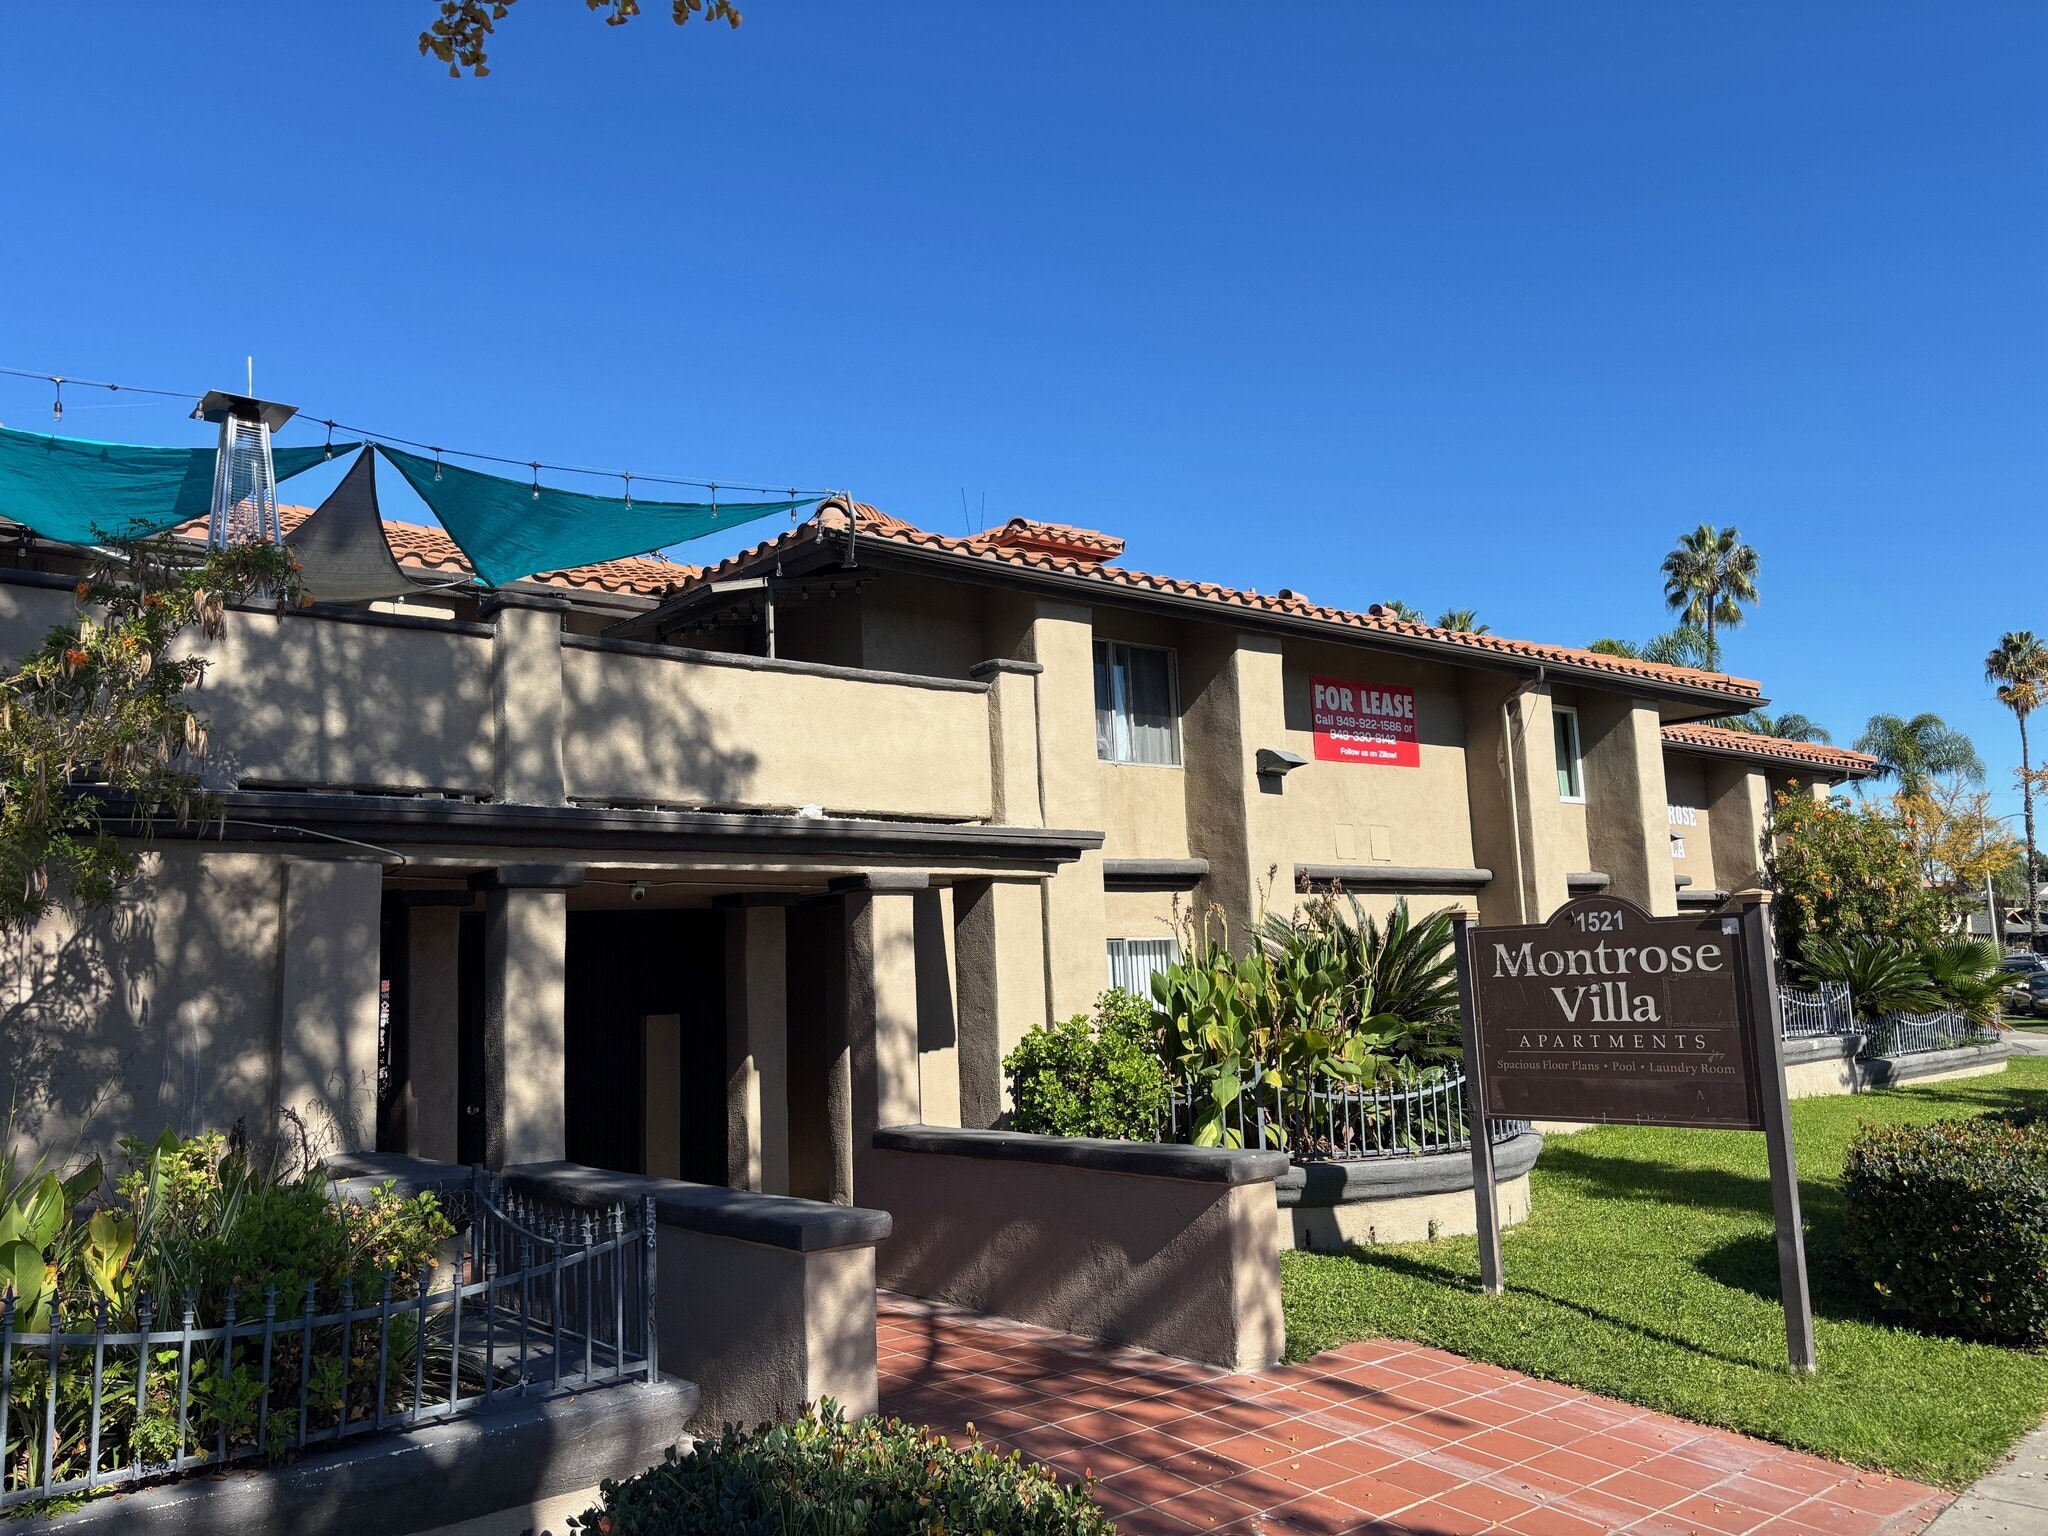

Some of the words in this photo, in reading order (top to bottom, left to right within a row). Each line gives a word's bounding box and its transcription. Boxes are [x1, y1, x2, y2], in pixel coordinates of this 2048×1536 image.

[1315, 684, 1354, 712] FOR
[1361, 690, 1413, 719] LEASE
[1315, 714, 1333, 725] Call
[1336, 716, 1401, 732] 949-922-1586
[1404, 725, 1413, 733] or
[1340, 747, 1359, 756] Follow
[1361, 749, 1369, 757] us
[1378, 750, 1397, 759] Zillow!
[1576, 910, 1624, 932] 1521
[1492, 939, 1724, 978] Montrose
[1550, 981, 1661, 1023] Villa
[1519, 1034, 1706, 1050] APARTMENTS
[1497, 1060, 1540, 1072] Spacious
[1542, 1060, 1569, 1071] Floor
[1571, 1060, 1600, 1071] Plans
[1612, 1061, 1636, 1072] Pool
[1649, 1062, 1698, 1076] Laundry
[1700, 1063, 1736, 1075] Room
